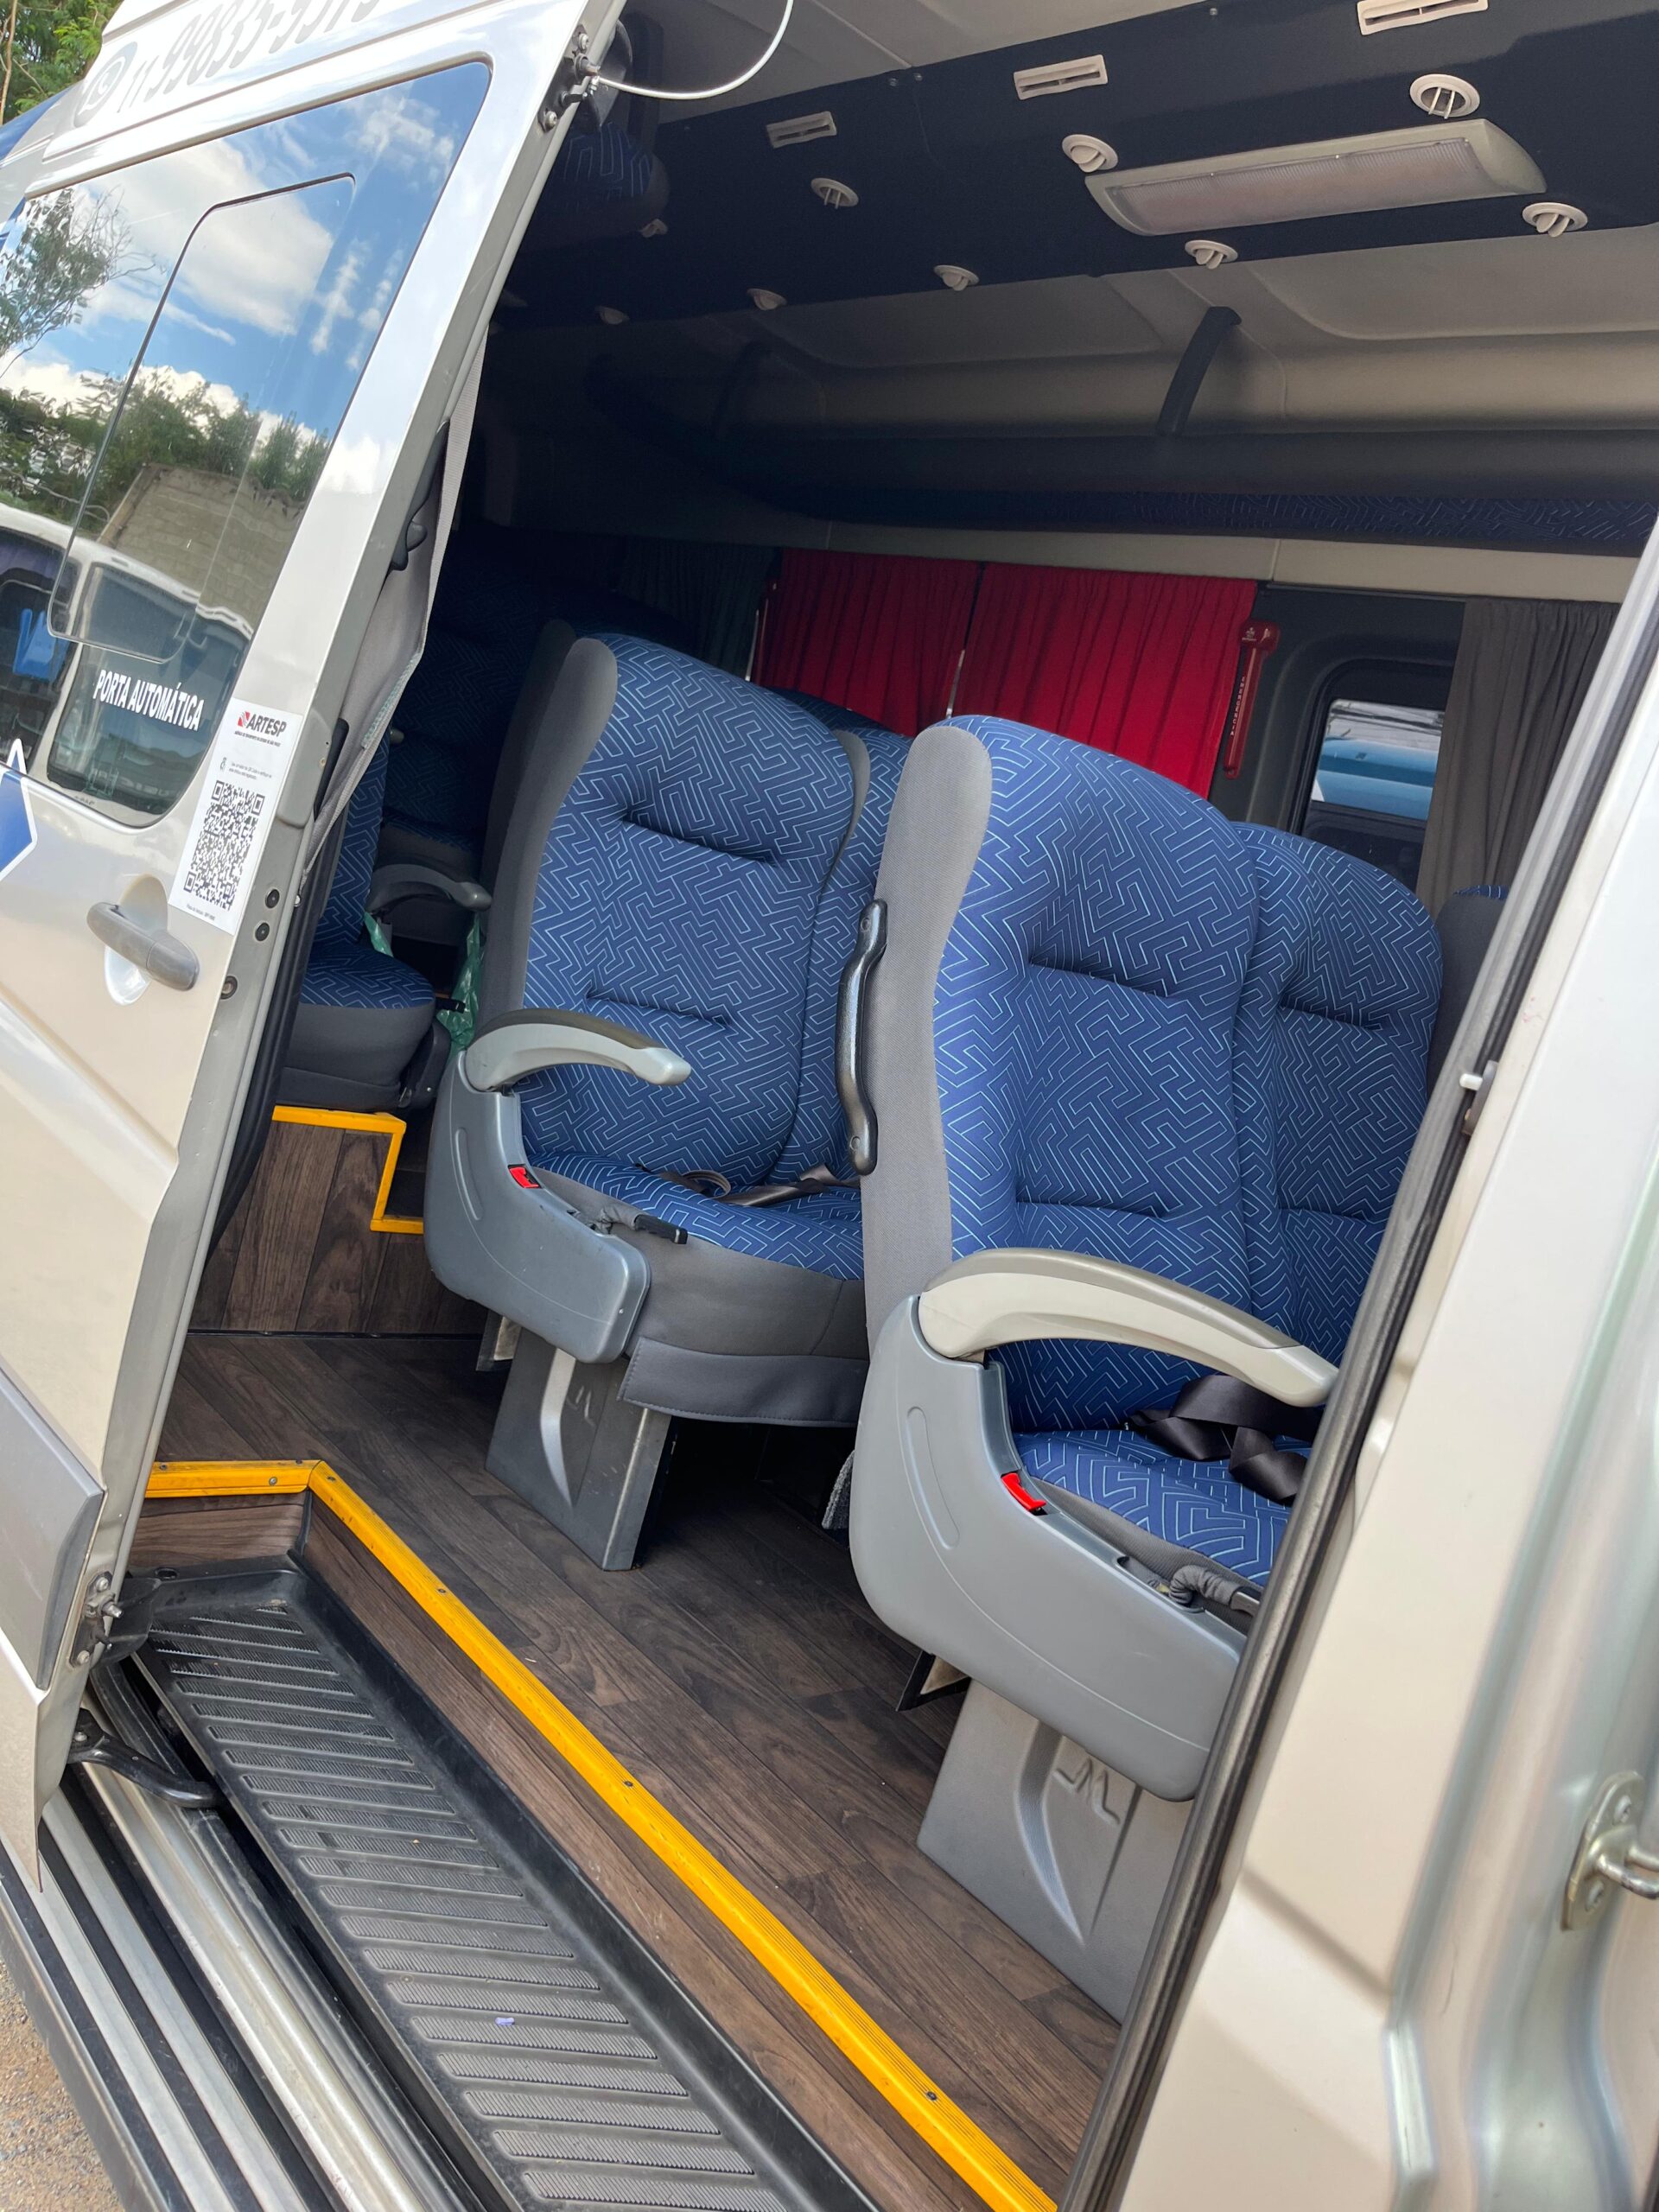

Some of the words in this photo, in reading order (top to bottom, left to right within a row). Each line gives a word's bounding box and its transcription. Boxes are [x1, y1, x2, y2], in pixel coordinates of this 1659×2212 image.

[92, 669, 131, 709] PORTA
[130, 680, 205, 732] AUTOMÁTICA
[246, 712, 288, 736] ARTESP
